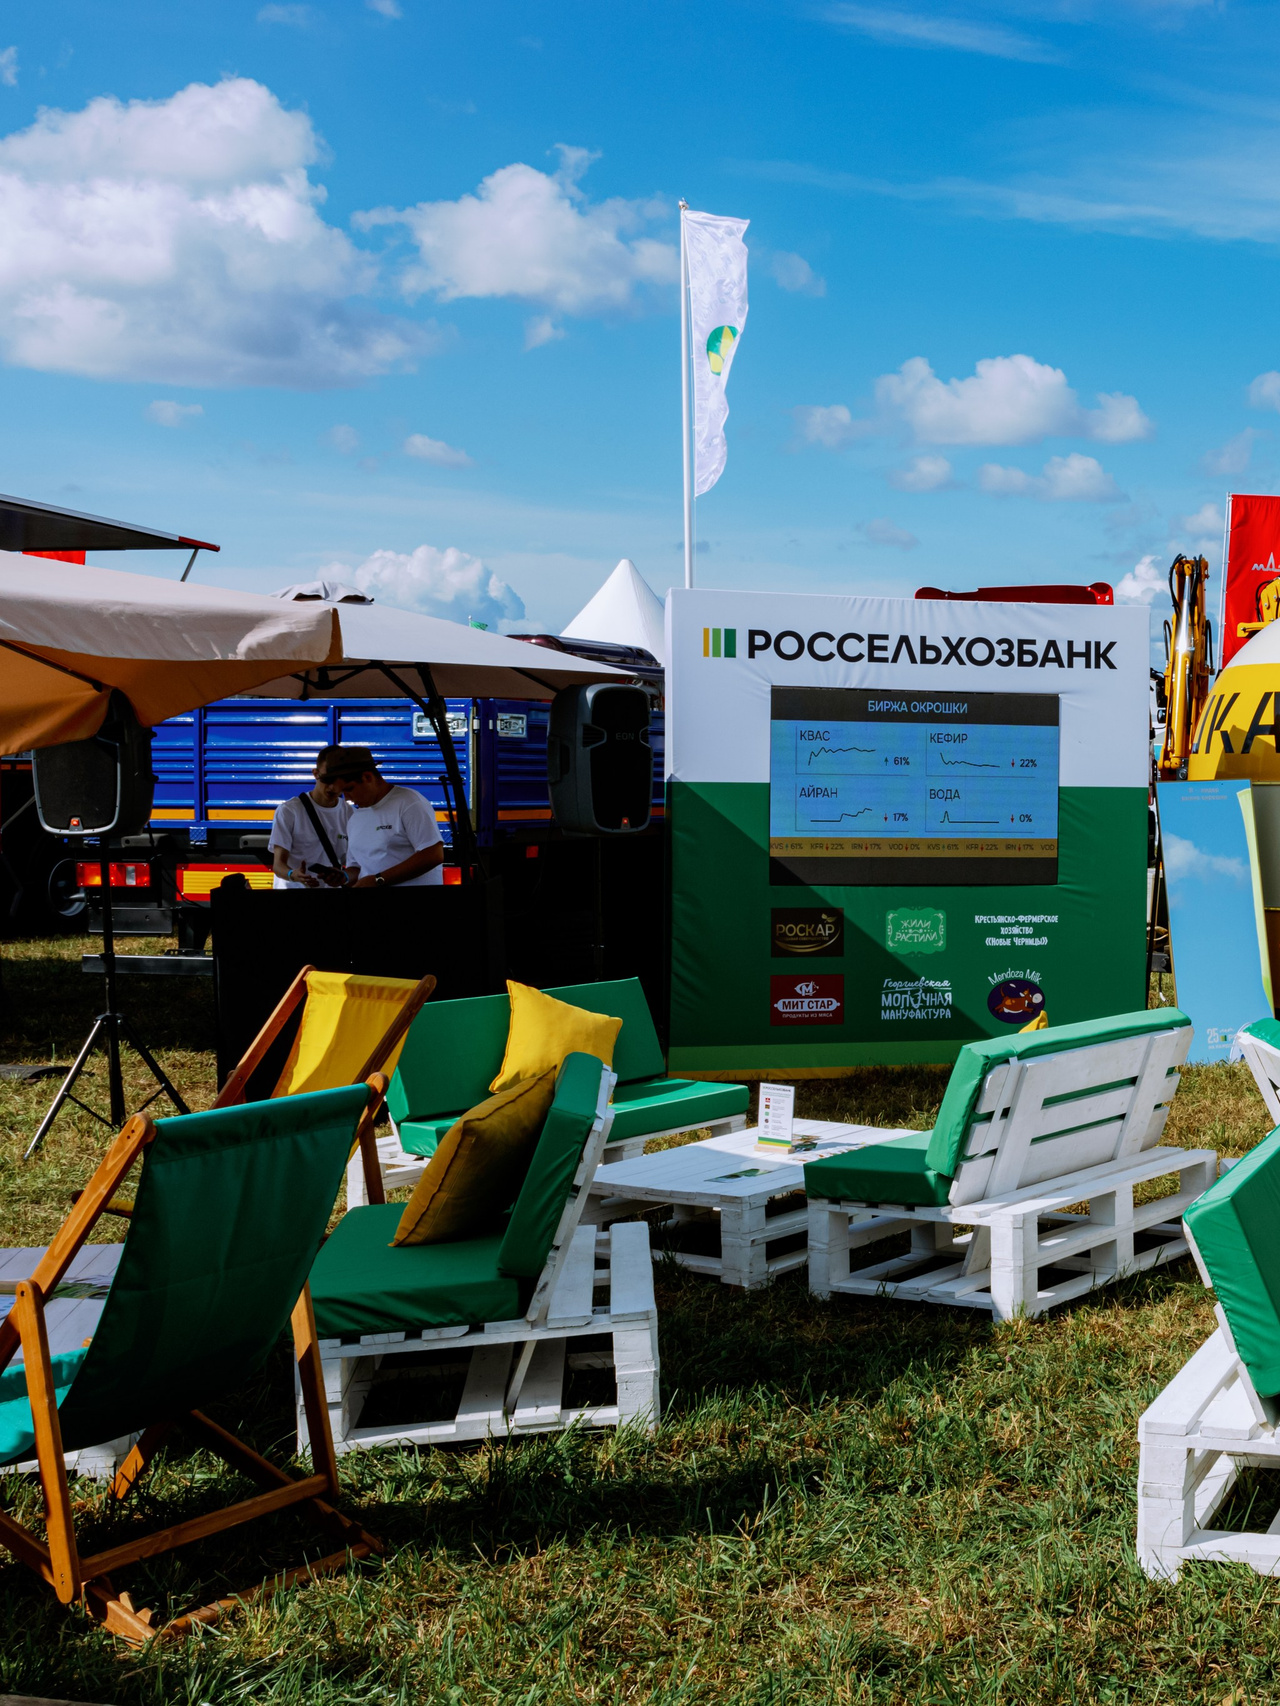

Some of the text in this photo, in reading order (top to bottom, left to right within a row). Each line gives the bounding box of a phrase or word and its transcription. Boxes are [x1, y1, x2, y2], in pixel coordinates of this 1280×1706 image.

[747, 628, 1118, 670] РОССЕЛЬХОЗБАНК
[868, 700, 968, 714] БИРЖА ОКРОШКИ
[615, 732, 635, 741] EON
[799, 730, 831, 742] КВАС
[929, 732, 969, 745] КЕФИР
[893, 756, 910, 766] 61%
[1019, 759, 1037, 768] 22%
[799, 784, 838, 799] АЙРАН
[929, 789, 961, 802] ВОДА
[893, 813, 909, 823] 17%
[1019, 813, 1033, 823] 0%
[927, 843, 941, 851] KVS
[946, 843, 959, 851] 61%
[985, 843, 999, 851] 22%
[1022, 843, 1034, 851] 17%
[776, 923, 835, 937] РОСКАР
[900, 919, 931, 929] ЖИЛИ
[894, 931, 937, 943] РАСТИЛИ
[987, 967, 1042, 986] Mendoza Milk
[882, 976, 951, 990] Георгиевская
[782, 999, 833, 1010] МИТ СТАР
[881, 1008, 952, 1020] МАНУФАКТУРА
